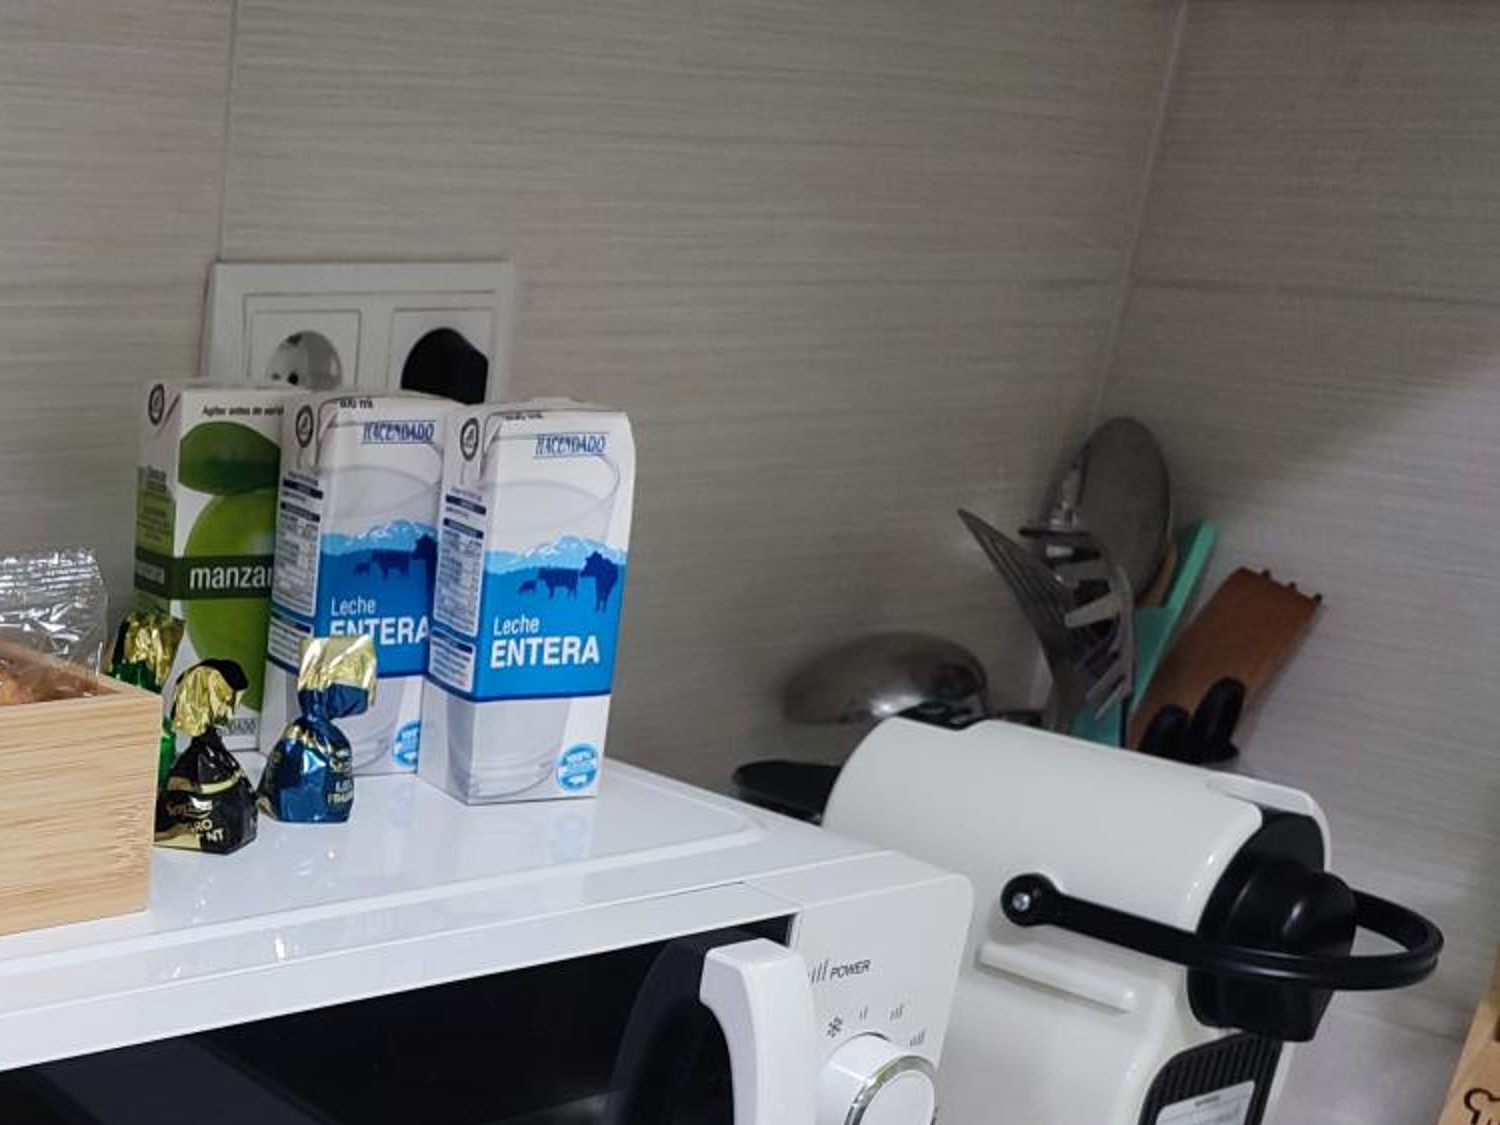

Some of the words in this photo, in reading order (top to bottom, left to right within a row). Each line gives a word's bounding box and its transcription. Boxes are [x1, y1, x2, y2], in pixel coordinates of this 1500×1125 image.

[362, 421, 436, 443] HACENDADO
[534, 433, 608, 457] HACENDADO
[190, 565, 274, 590] manza
[331, 597, 377, 617] Leche
[329, 615, 430, 646] ENTERA
[493, 613, 541, 637] Leche
[489, 634, 601, 669] ENTERA
[829, 959, 871, 980] POWER
